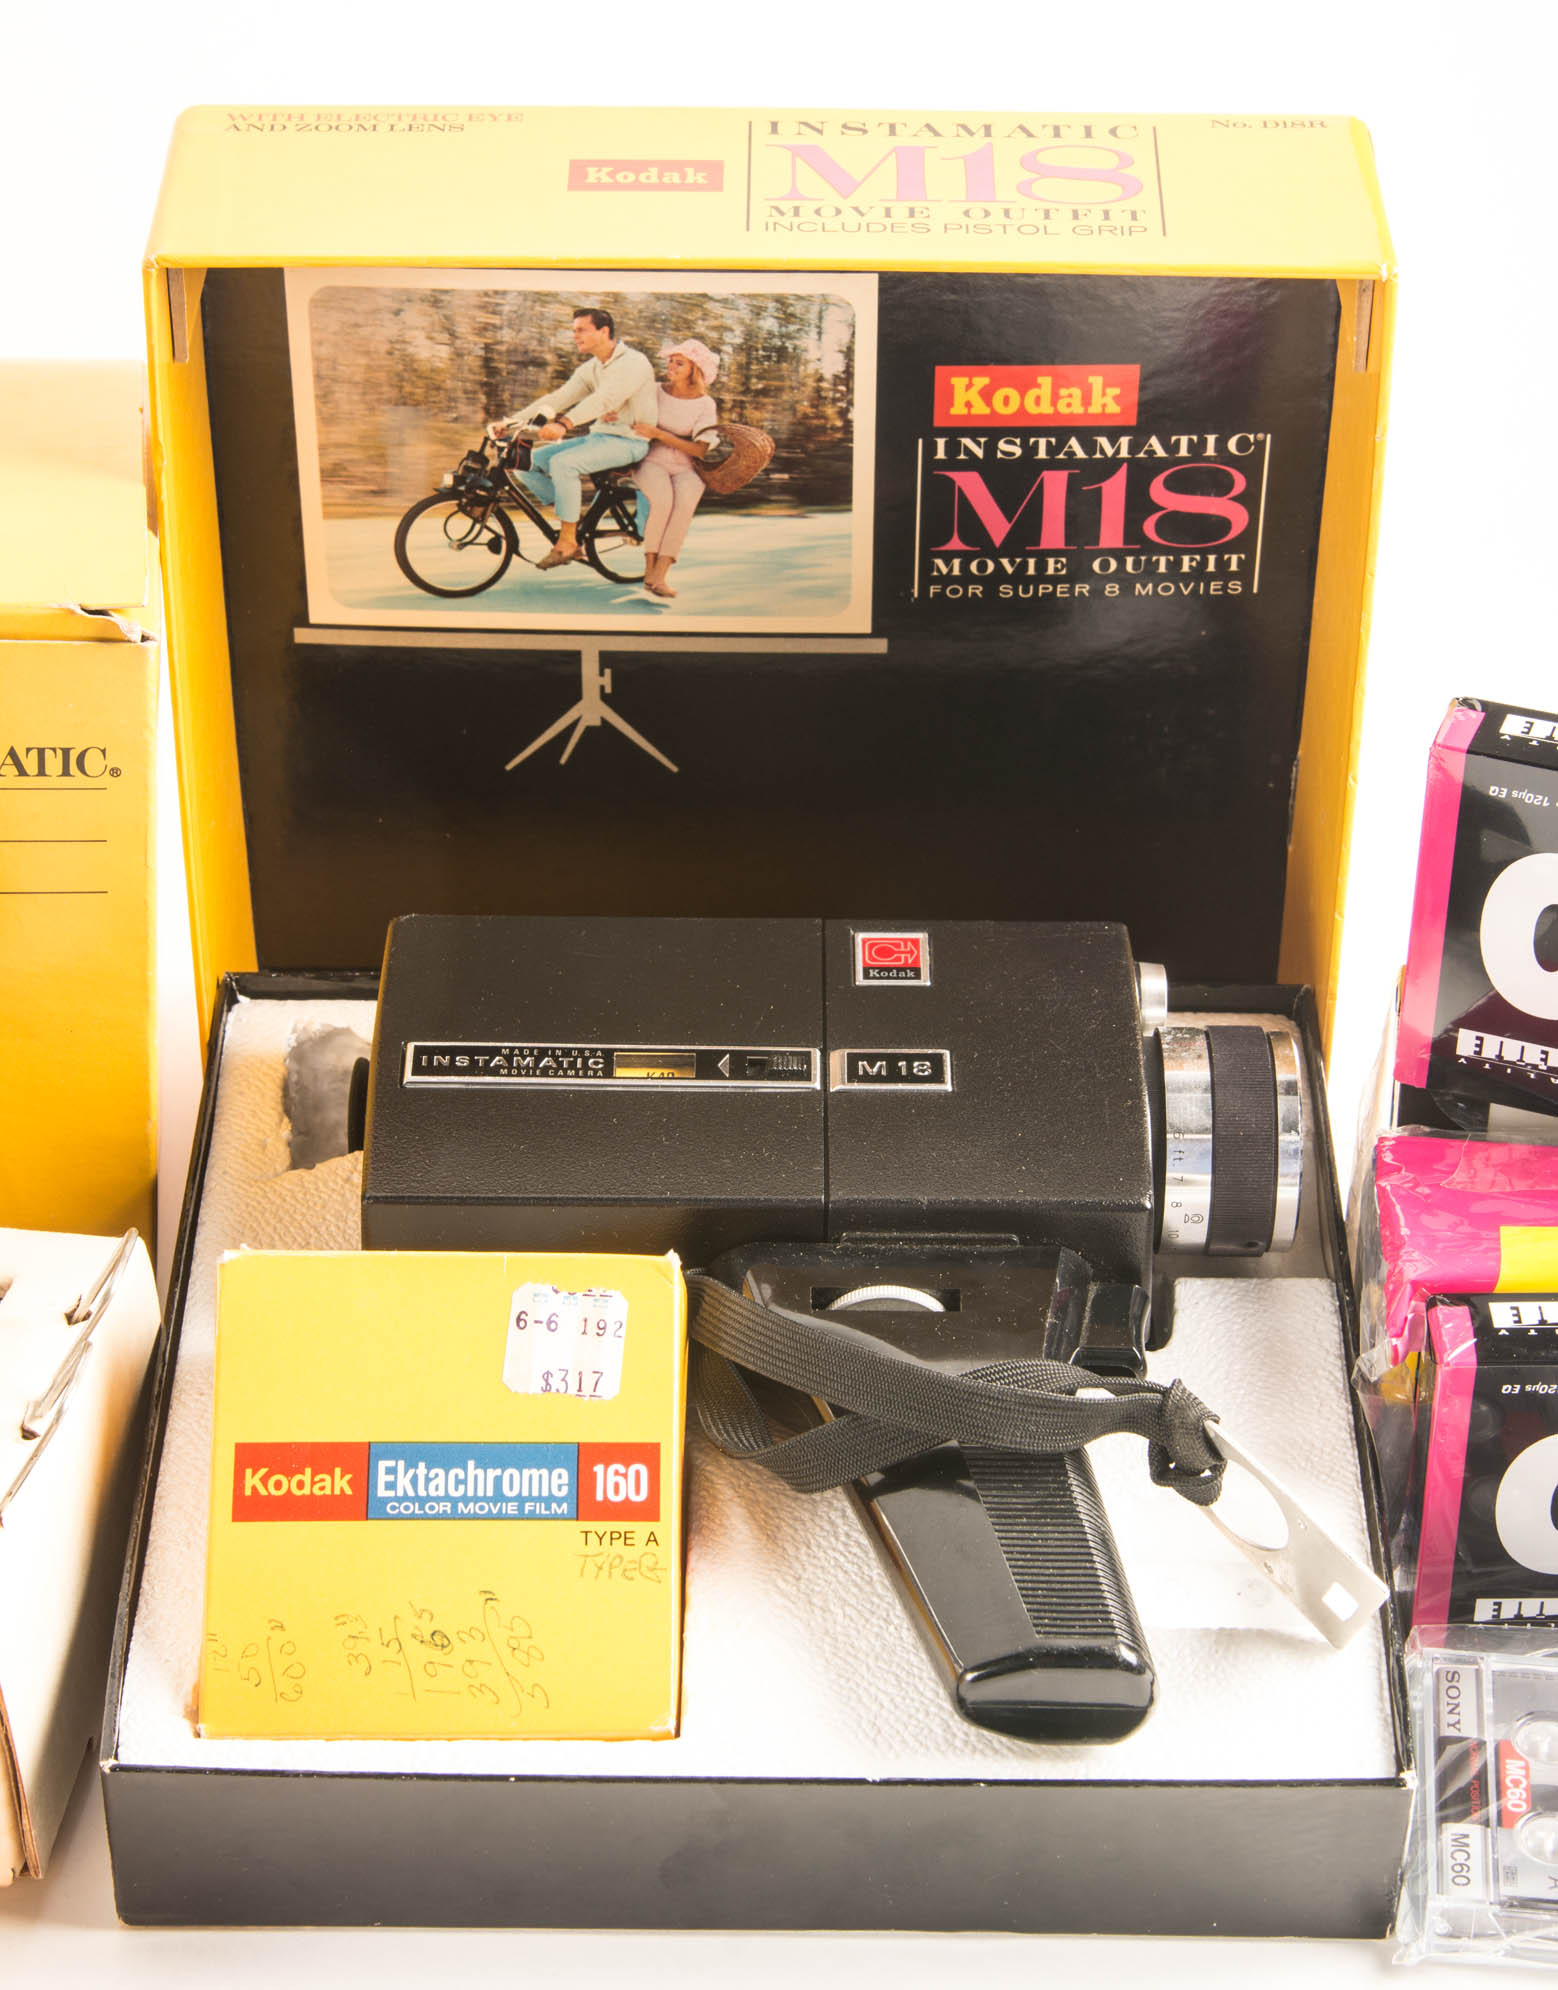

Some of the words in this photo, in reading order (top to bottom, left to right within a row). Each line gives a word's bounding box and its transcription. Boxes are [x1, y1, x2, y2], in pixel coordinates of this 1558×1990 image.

[226, 112, 306, 122] WITH
[315, 112, 460, 122] ELECTRIC
[467, 112, 526, 122] EYE
[1209, 119, 1252, 129] No.
[224, 122, 288, 132] AND
[295, 122, 378, 132] ZOOM
[388, 122, 466, 132] LENS
[767, 120, 1139, 140] INSTAMATIC
[584, 166, 708, 185] Kodak
[763, 141, 1144, 206] M18
[767, 205, 932, 219] MOVIE
[962, 207, 1146, 222] OUTFIT
[764, 221, 932, 234] INCLUDES
[943, 223, 1061, 236] PISTOL
[1071, 225, 1148, 237] GRIP
[949, 376, 1121, 415] Kodak
[930, 462, 1250, 551] M18
[930, 556, 1068, 577] MOVIE
[1092, 553, 1246, 574] OUTFIT
[929, 584, 984, 599] FOR
[999, 583, 1090, 598] SUPER
[1103, 583, 1120, 597] 8
[1134, 580, 1244, 596] MOVIES
[1488, 785, 1508, 799] EQ
[868, 968, 916, 978] Kodak
[418, 1054, 605, 1068] INSTAMATIC
[500, 1048, 541, 1056] MADE
[547, 1049, 563, 1057] IN
[499, 1067, 542, 1076] MOVIE
[548, 1068, 605, 1077] CAMERA
[515, 1310, 560, 1333] 6-6
[581, 1317, 624, 1339] 192
[1501, 1384, 1521, 1394] EQ
[244, 1467, 353, 1497] Kodak
[377, 1460, 569, 1499] Ektachrome
[592, 1463, 649, 1503] 160
[386, 1501, 453, 1515] COLOR
[457, 1501, 519, 1515] MOVIE
[524, 1501, 569, 1515] FILM
[579, 1530, 636, 1546] TYPE
[645, 1530, 660, 1546] A
[1445, 1669, 1462, 1734] SONY
[1505, 1759, 1528, 1813] MC60
[1450, 1832, 1471, 1887] MC60
